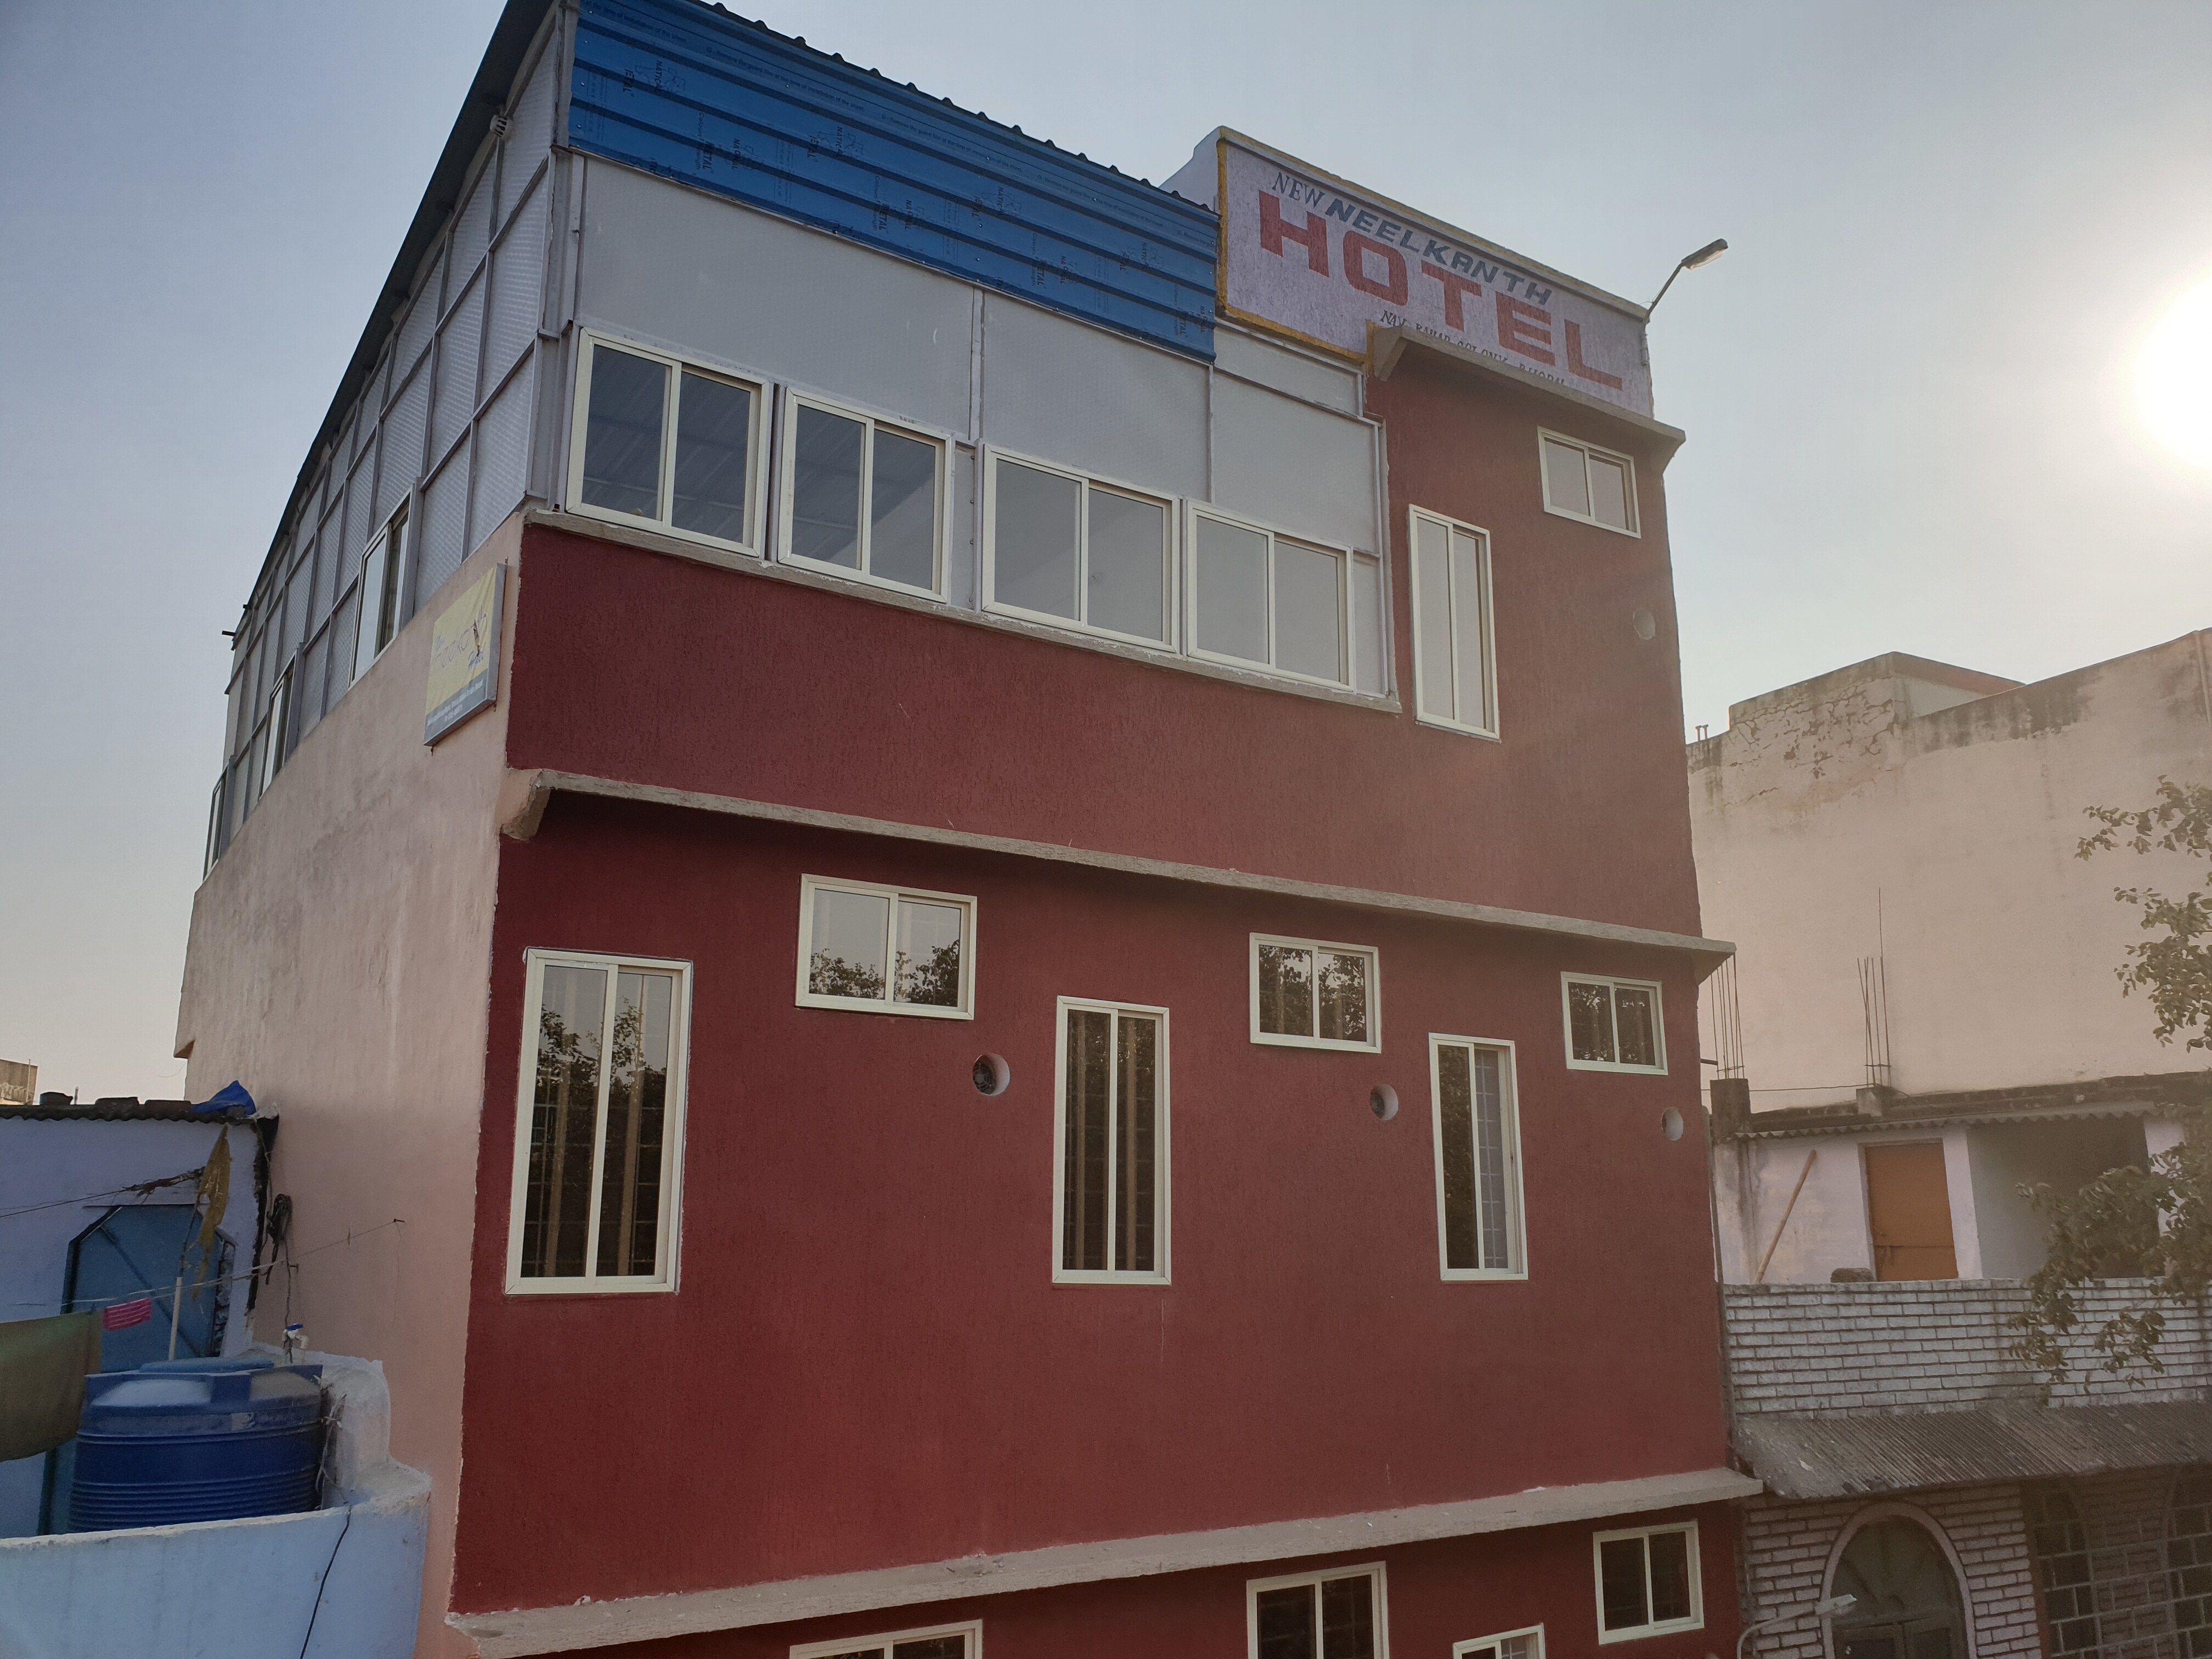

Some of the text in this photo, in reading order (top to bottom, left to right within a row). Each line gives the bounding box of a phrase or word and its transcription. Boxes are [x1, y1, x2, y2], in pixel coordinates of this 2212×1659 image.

[1258, 189, 1623, 391] HOTEL
[1272, 172, 1553, 306] NEW NEELKANTH
